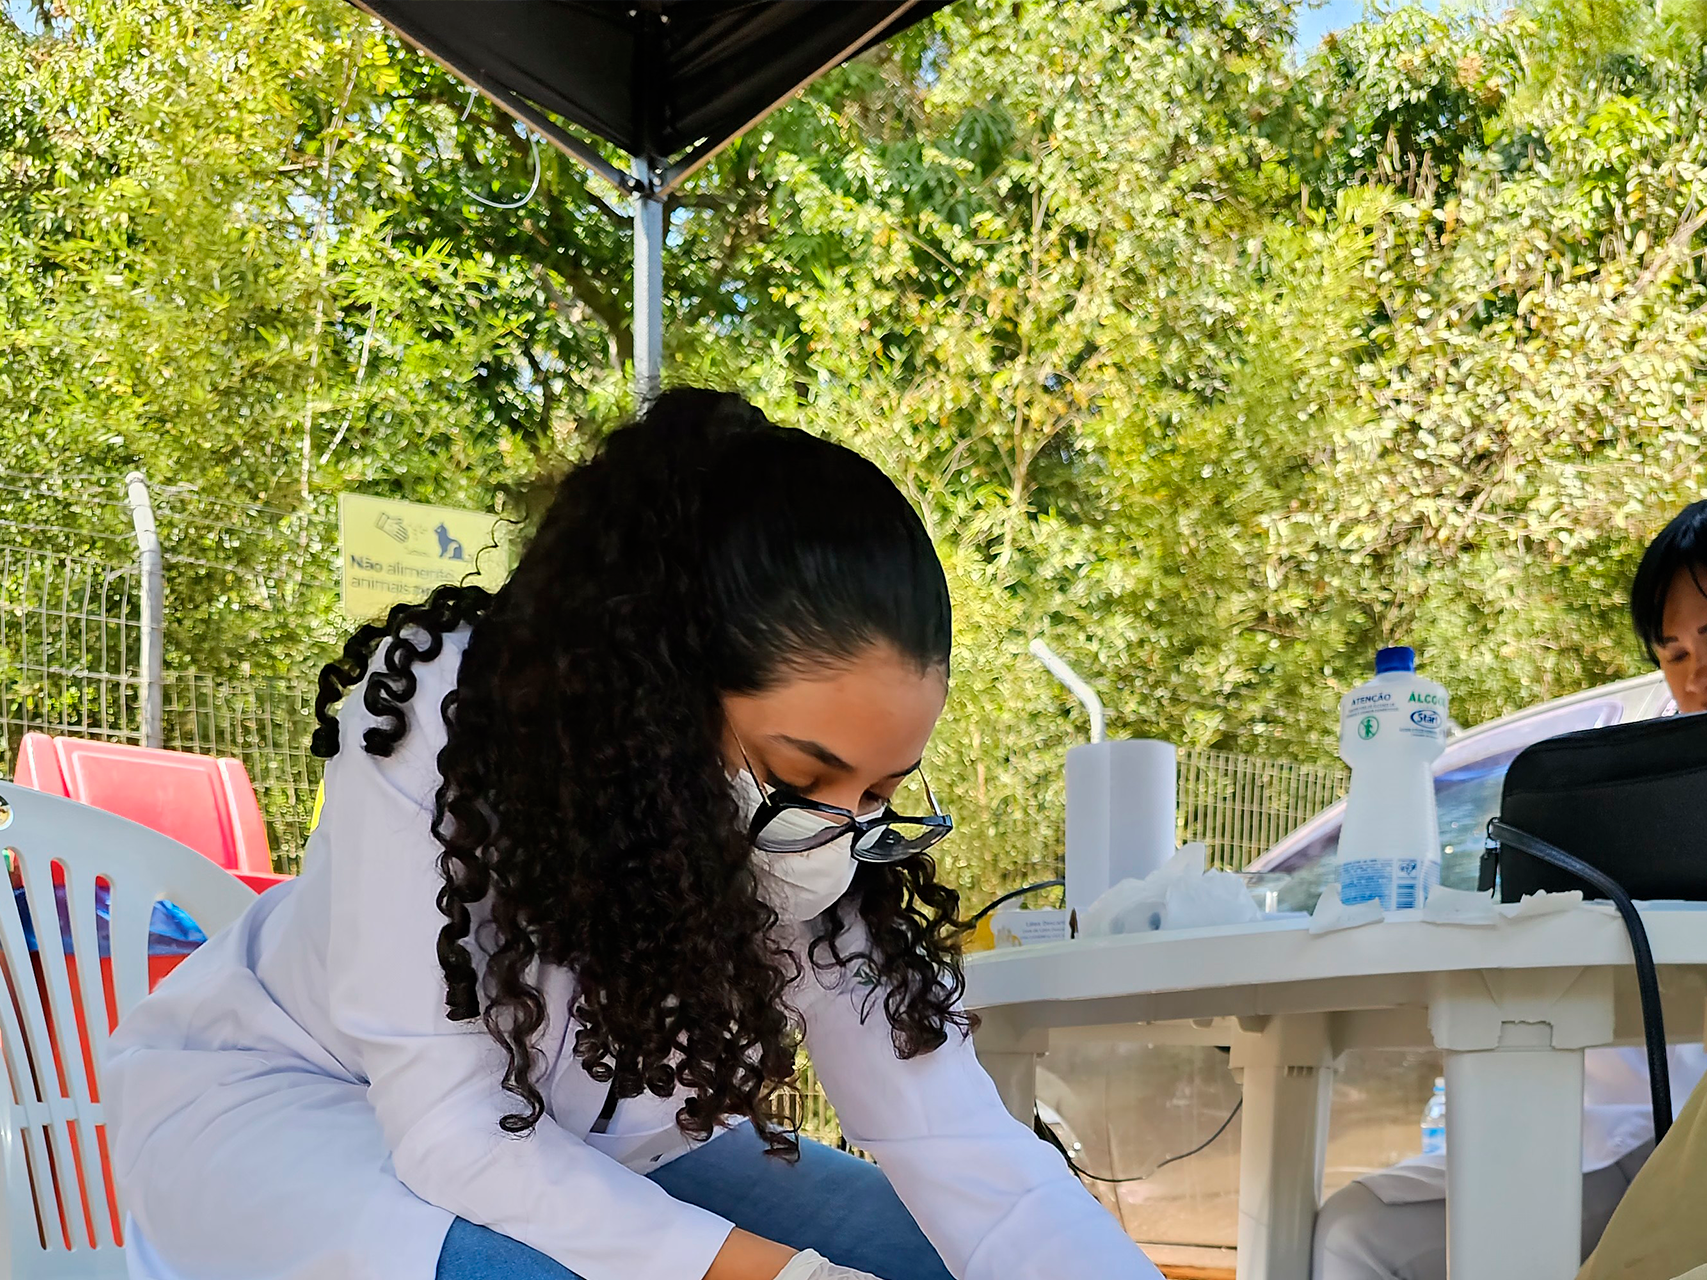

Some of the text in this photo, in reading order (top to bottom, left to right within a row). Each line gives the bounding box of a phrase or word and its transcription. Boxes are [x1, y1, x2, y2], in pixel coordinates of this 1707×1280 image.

[350, 554, 383, 572] Não
[351, 576, 411, 595] animais
[1351, 692, 1391, 706] ATENÇÃO
